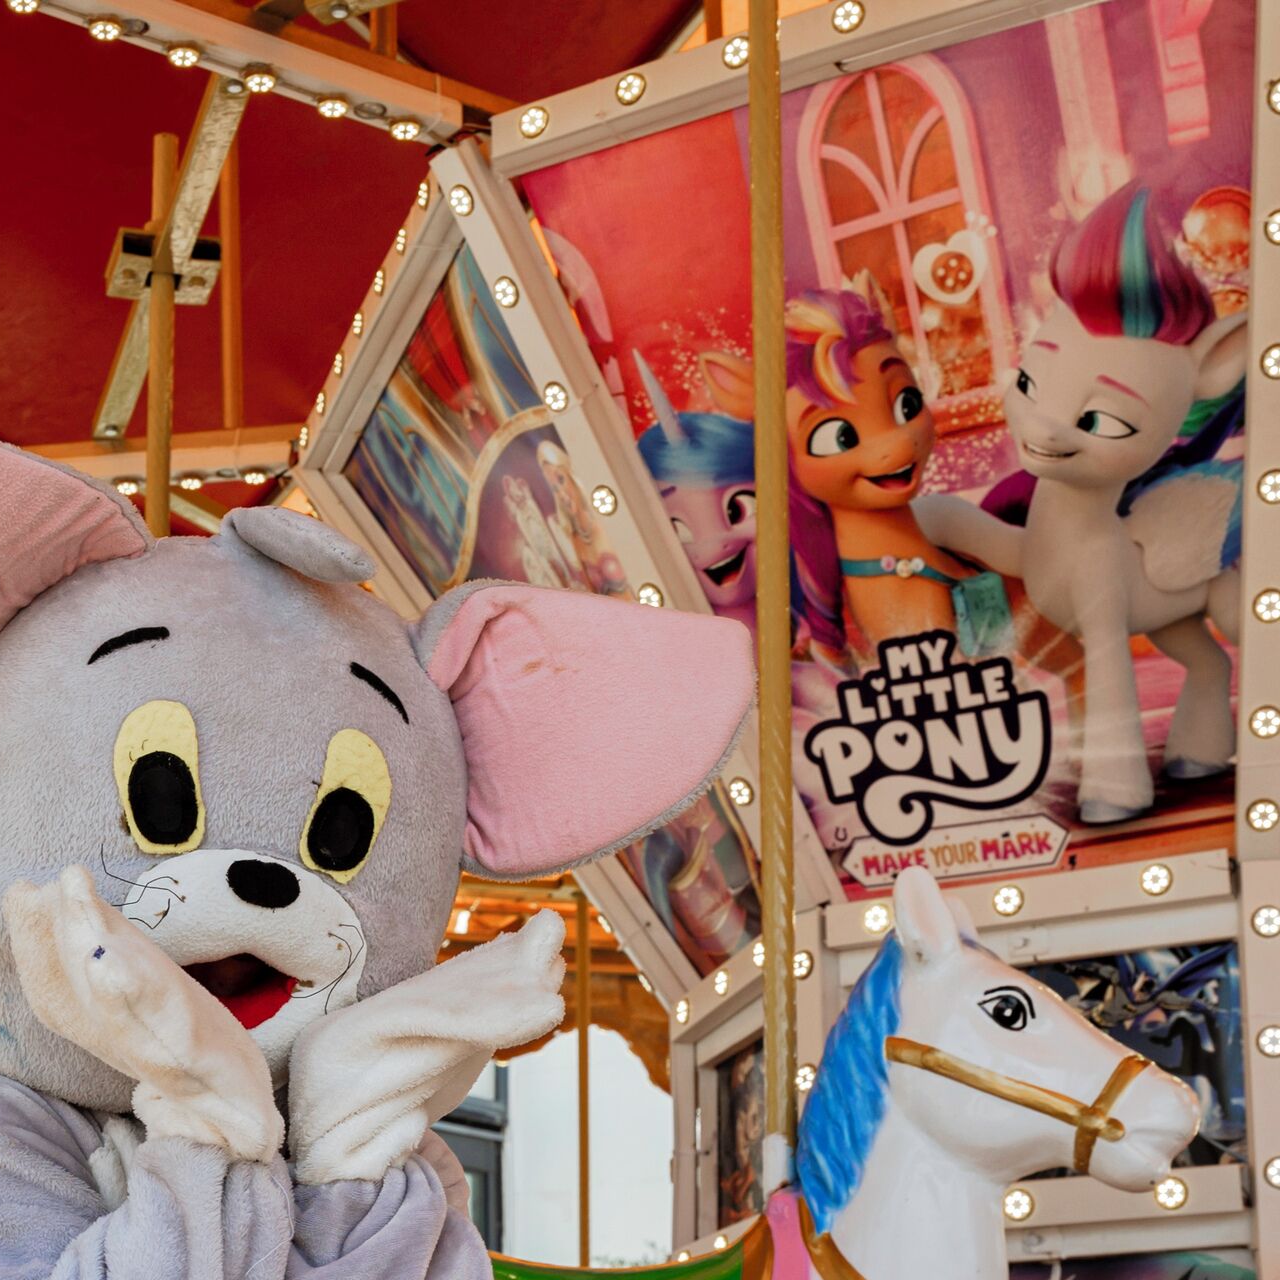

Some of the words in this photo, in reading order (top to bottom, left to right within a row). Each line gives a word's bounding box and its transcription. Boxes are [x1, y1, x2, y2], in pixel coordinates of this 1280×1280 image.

[884, 636, 949, 681] MY
[843, 664, 1011, 726] LITTLE
[809, 698, 1045, 839] PONY
[861, 847, 930, 877] MAKE
[929, 841, 980, 868] YOUR
[980, 830, 1053, 862] MARK
